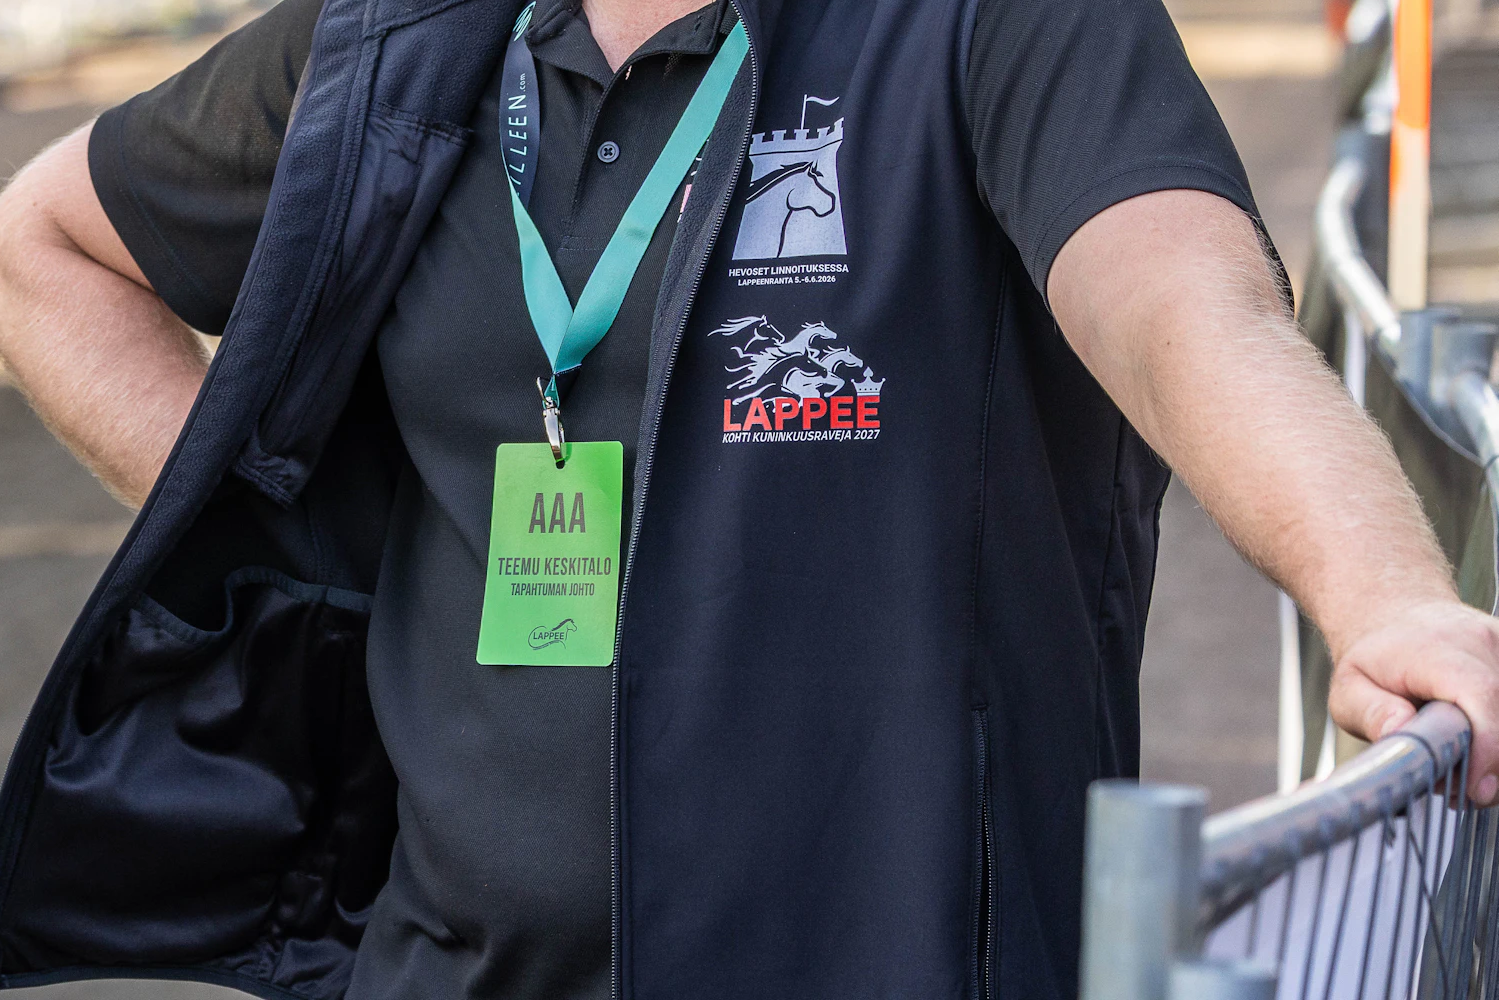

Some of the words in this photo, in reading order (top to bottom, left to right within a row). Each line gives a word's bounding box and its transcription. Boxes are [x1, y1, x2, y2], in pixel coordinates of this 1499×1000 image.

[729, 266, 769, 277] HEVOSET
[771, 264, 849, 275] LINNOITUKSESSA
[738, 277, 793, 286] LAPPEENRANTA
[795, 275, 836, 284] 5.-6.6.2026
[723, 396, 880, 432] LAPPEE
[722, 432, 751, 443] KOHTI
[752, 430, 852, 442] KUNINKUUSRAVEJA
[854, 429, 880, 440] 2027
[528, 492, 586, 533] AAA
[498, 558, 540, 575] TEEMU
[544, 557, 611, 575] KESKITALO
[511, 583, 567, 596] TAPAHTUMAN
[568, 583, 595, 596] JOHTO
[533, 632, 564, 640] LAPPEE
